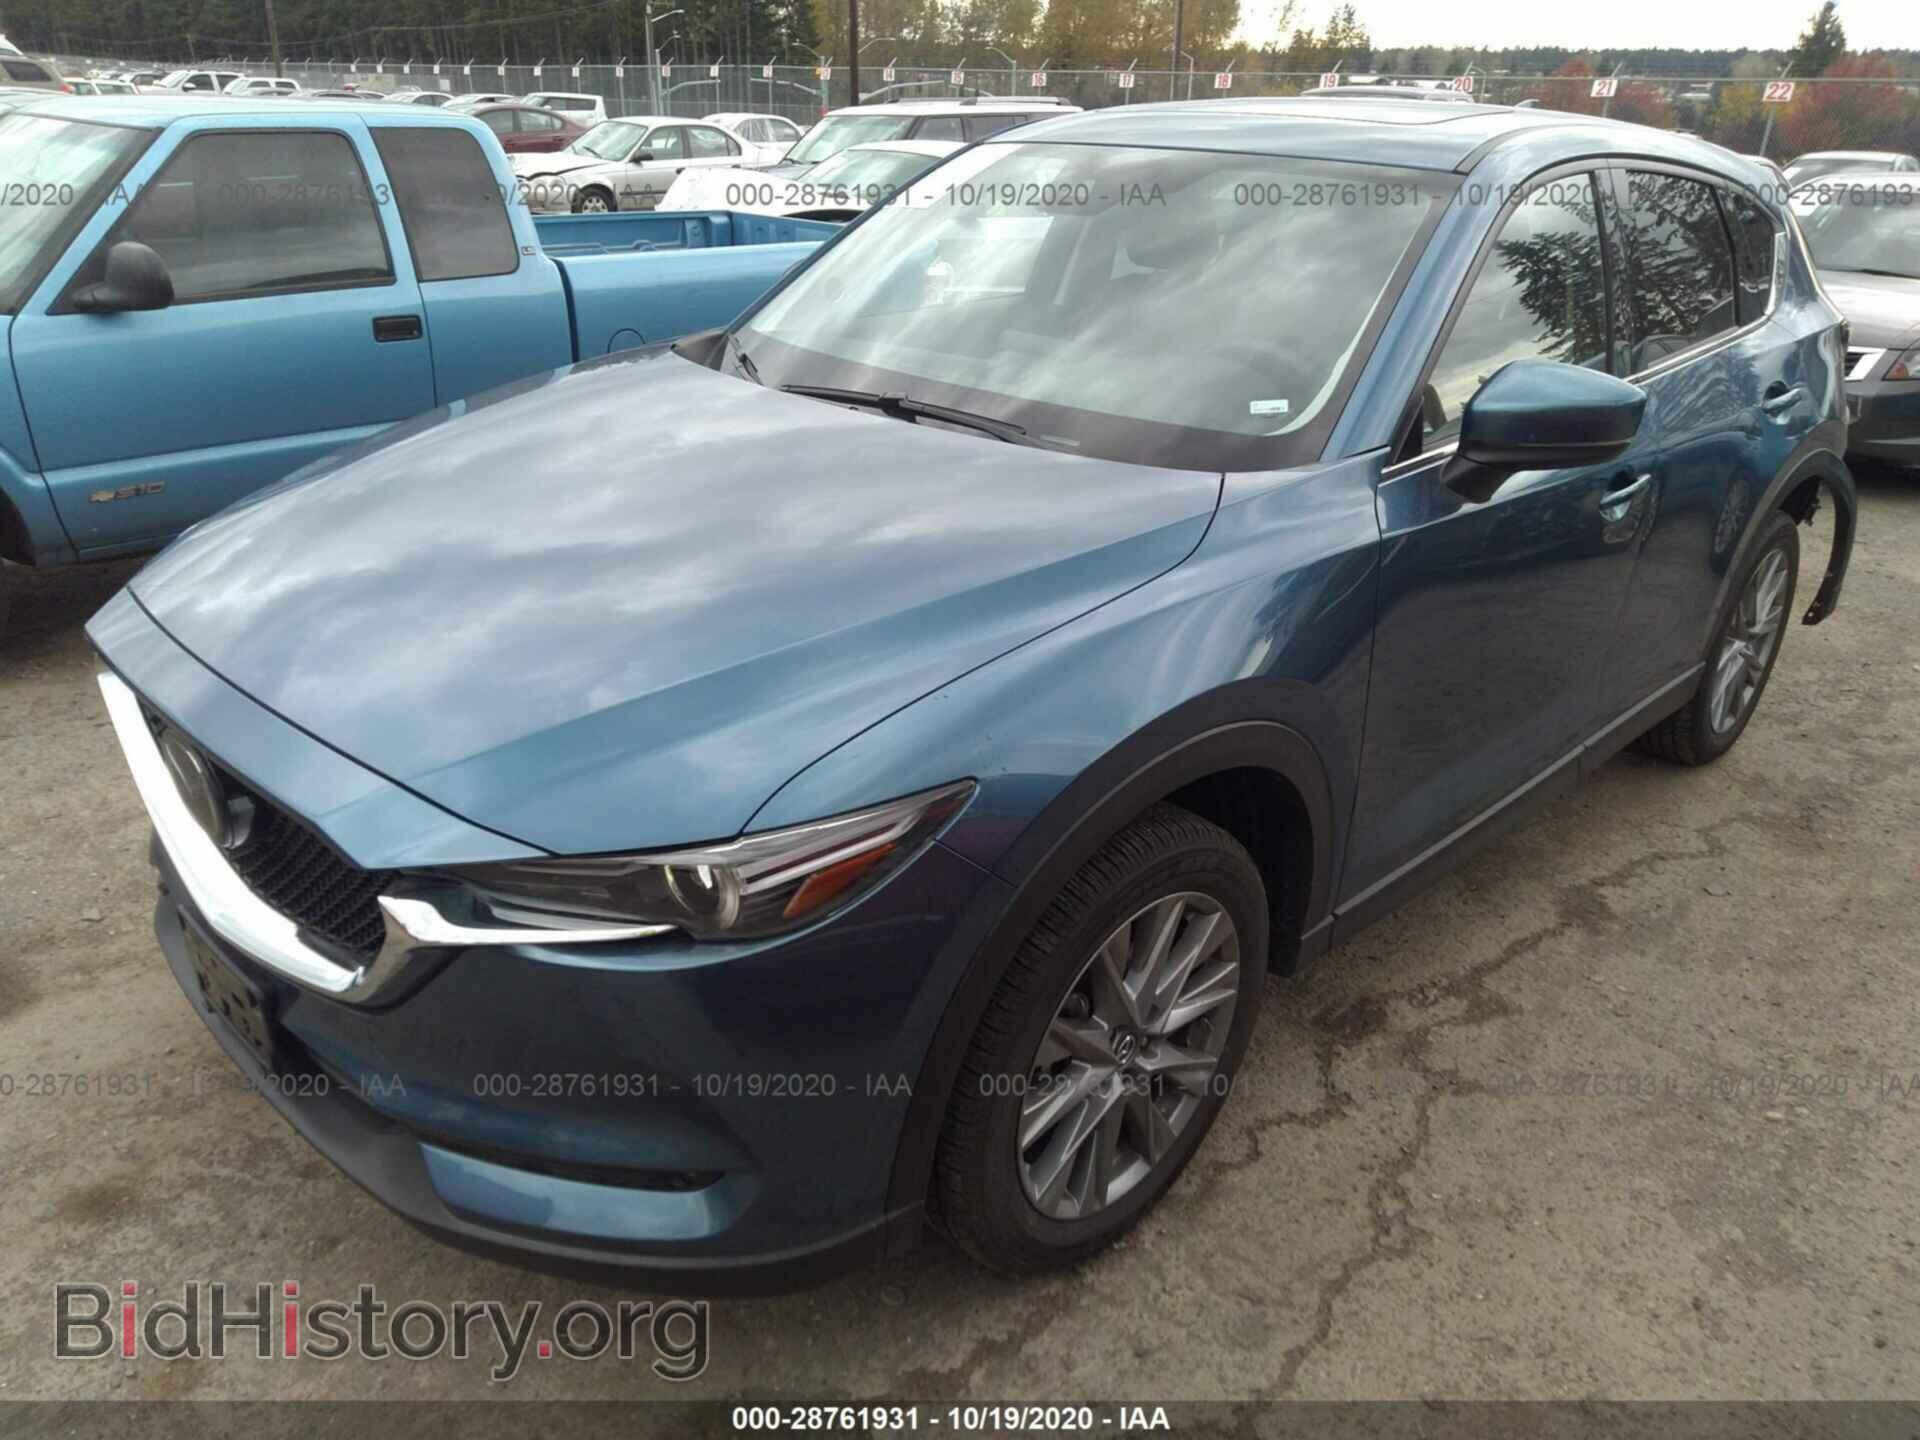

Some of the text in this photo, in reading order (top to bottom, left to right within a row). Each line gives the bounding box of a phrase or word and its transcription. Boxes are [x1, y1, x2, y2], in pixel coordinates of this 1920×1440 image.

[1323, 74, 1336, 88] 19
[1454, 76, 1472, 92] 20
[1596, 80, 1613, 96] 21
[1766, 83, 1791, 100] 22
